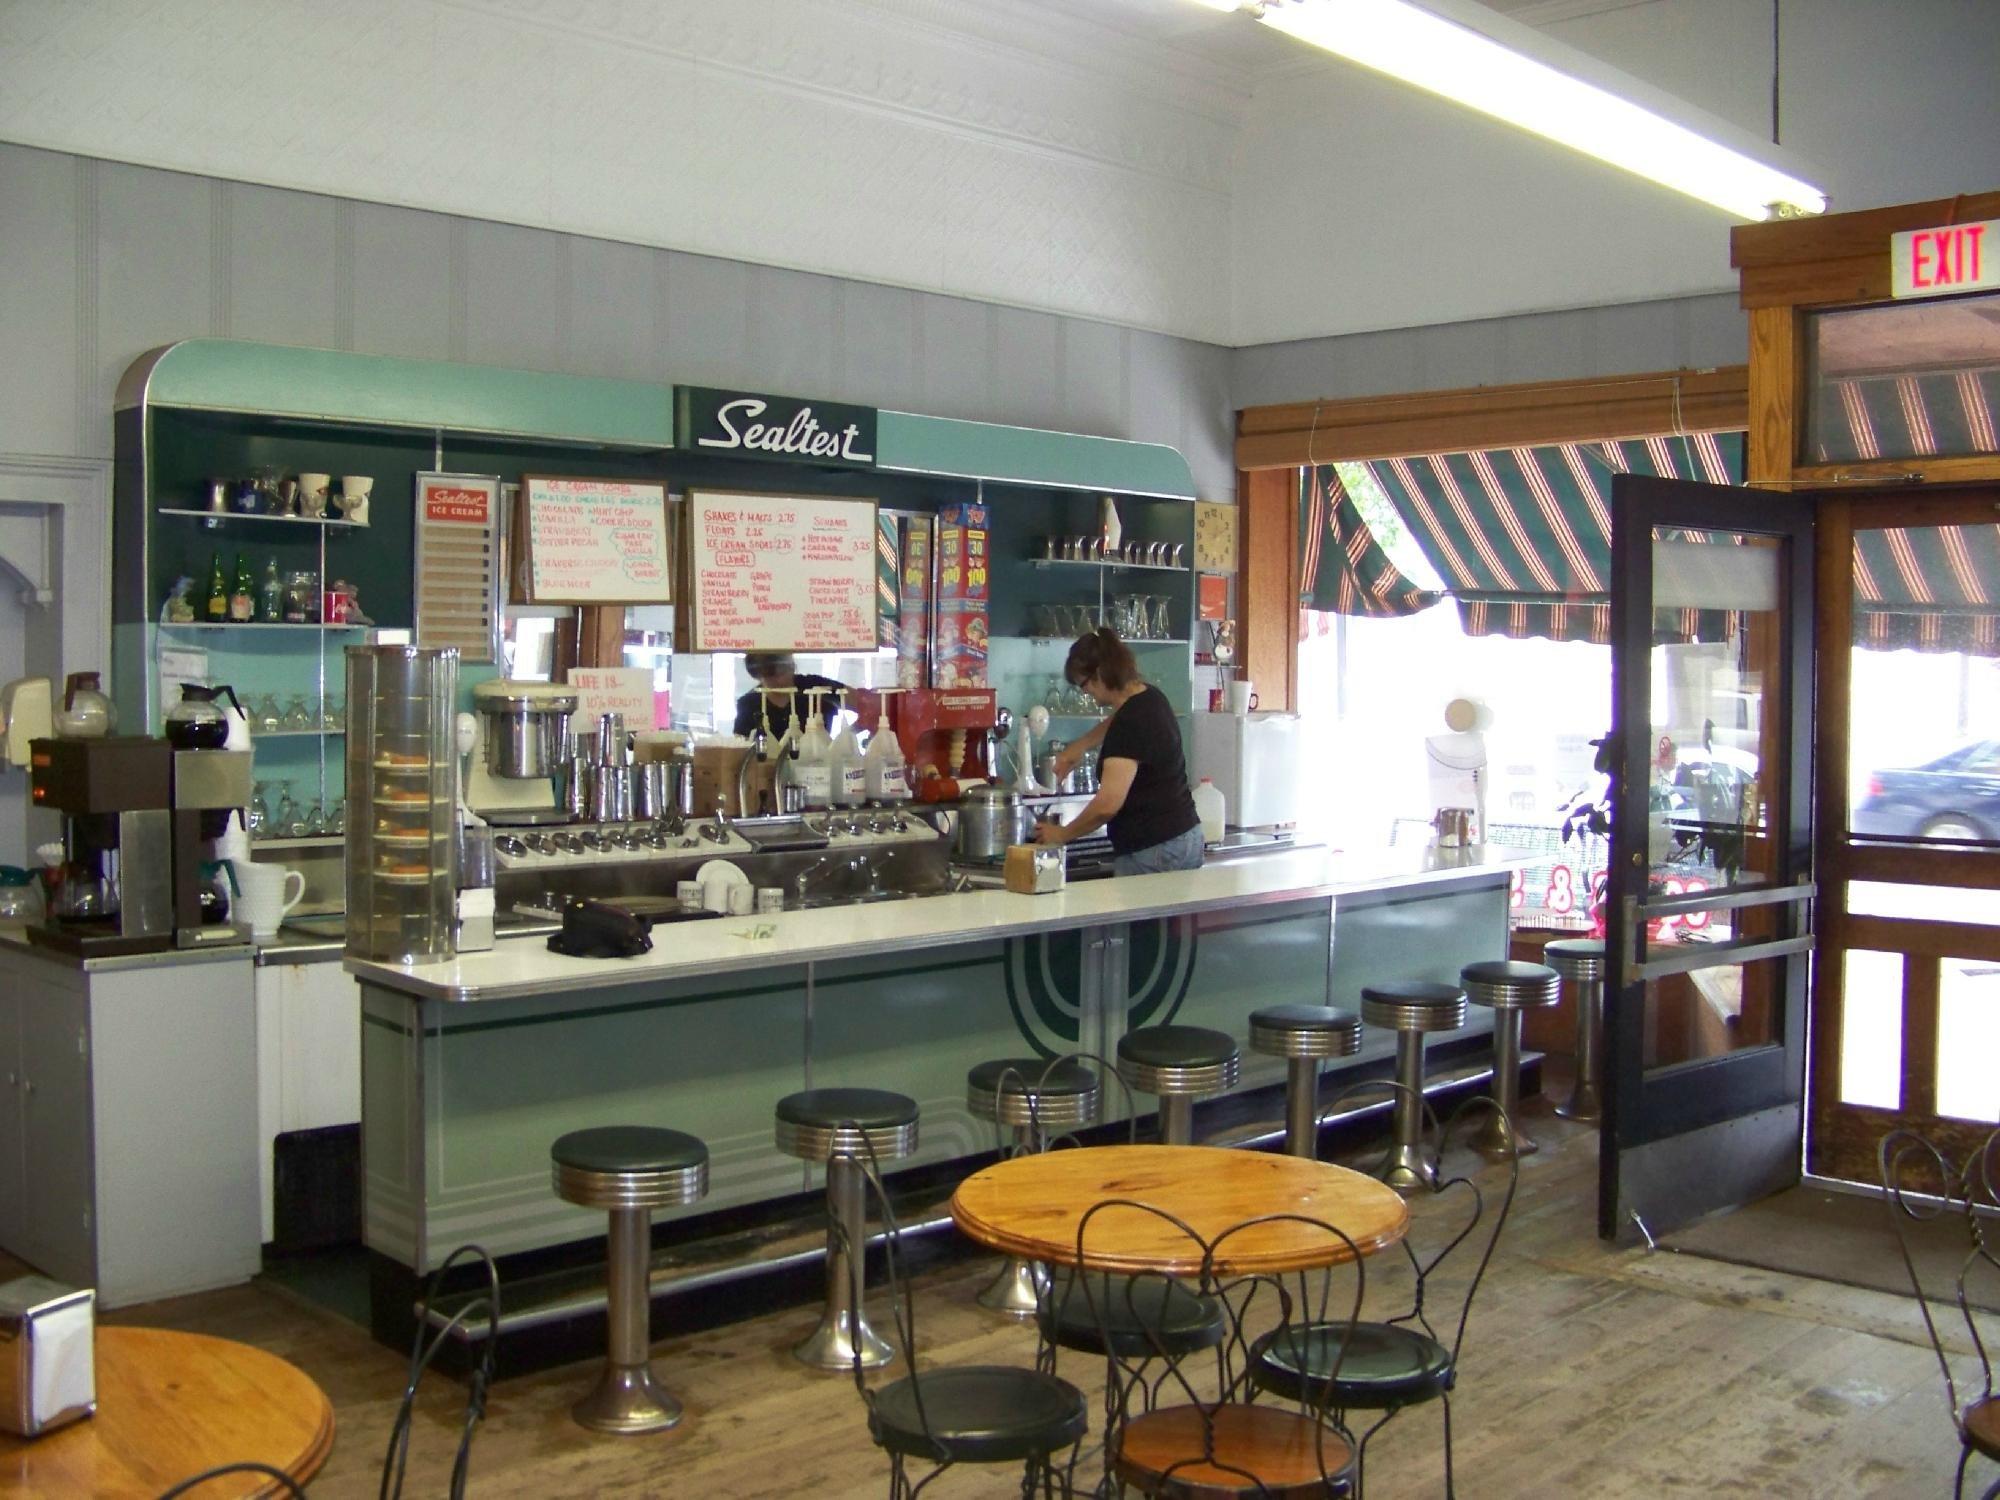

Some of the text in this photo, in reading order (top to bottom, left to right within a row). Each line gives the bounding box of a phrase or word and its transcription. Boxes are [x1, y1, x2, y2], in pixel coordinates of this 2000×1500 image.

[1912, 226, 1986, 288] EXIT
[698, 399, 873, 462] Sealtest
[427, 490, 487, 507] Sealtest
[432, 506, 483, 516] ICE CREAM
[592, 507, 634, 516] MINT CHIP
[537, 513, 575, 523] VANILLA
[704, 510, 738, 522] SHAKES
[747, 513, 772, 523] MALTS
[778, 513, 796, 523] 2.75
[627, 519, 653, 527] DOUGH
[705, 525, 736, 537] FLOATS
[706, 539, 718, 549] ICE
[720, 540, 746, 550] CREAM
[749, 540, 773, 550] SODAS
[853, 541, 871, 550] 3.25
[970, 541, 983, 555] 30
[719, 554, 751, 564] FLAVORS
[701, 570, 737, 579] CHOCOLATE
[968, 567, 986, 588] 100
[809, 578, 854, 586] STRAWBERRY
[703, 589, 749, 598] STRAWBERRY
[703, 598, 732, 606] ORANGE
[810, 596, 849, 605] PINEAPPLE
[575, 674, 599, 689] LIFE
[607, 695, 642, 708] REALITY
